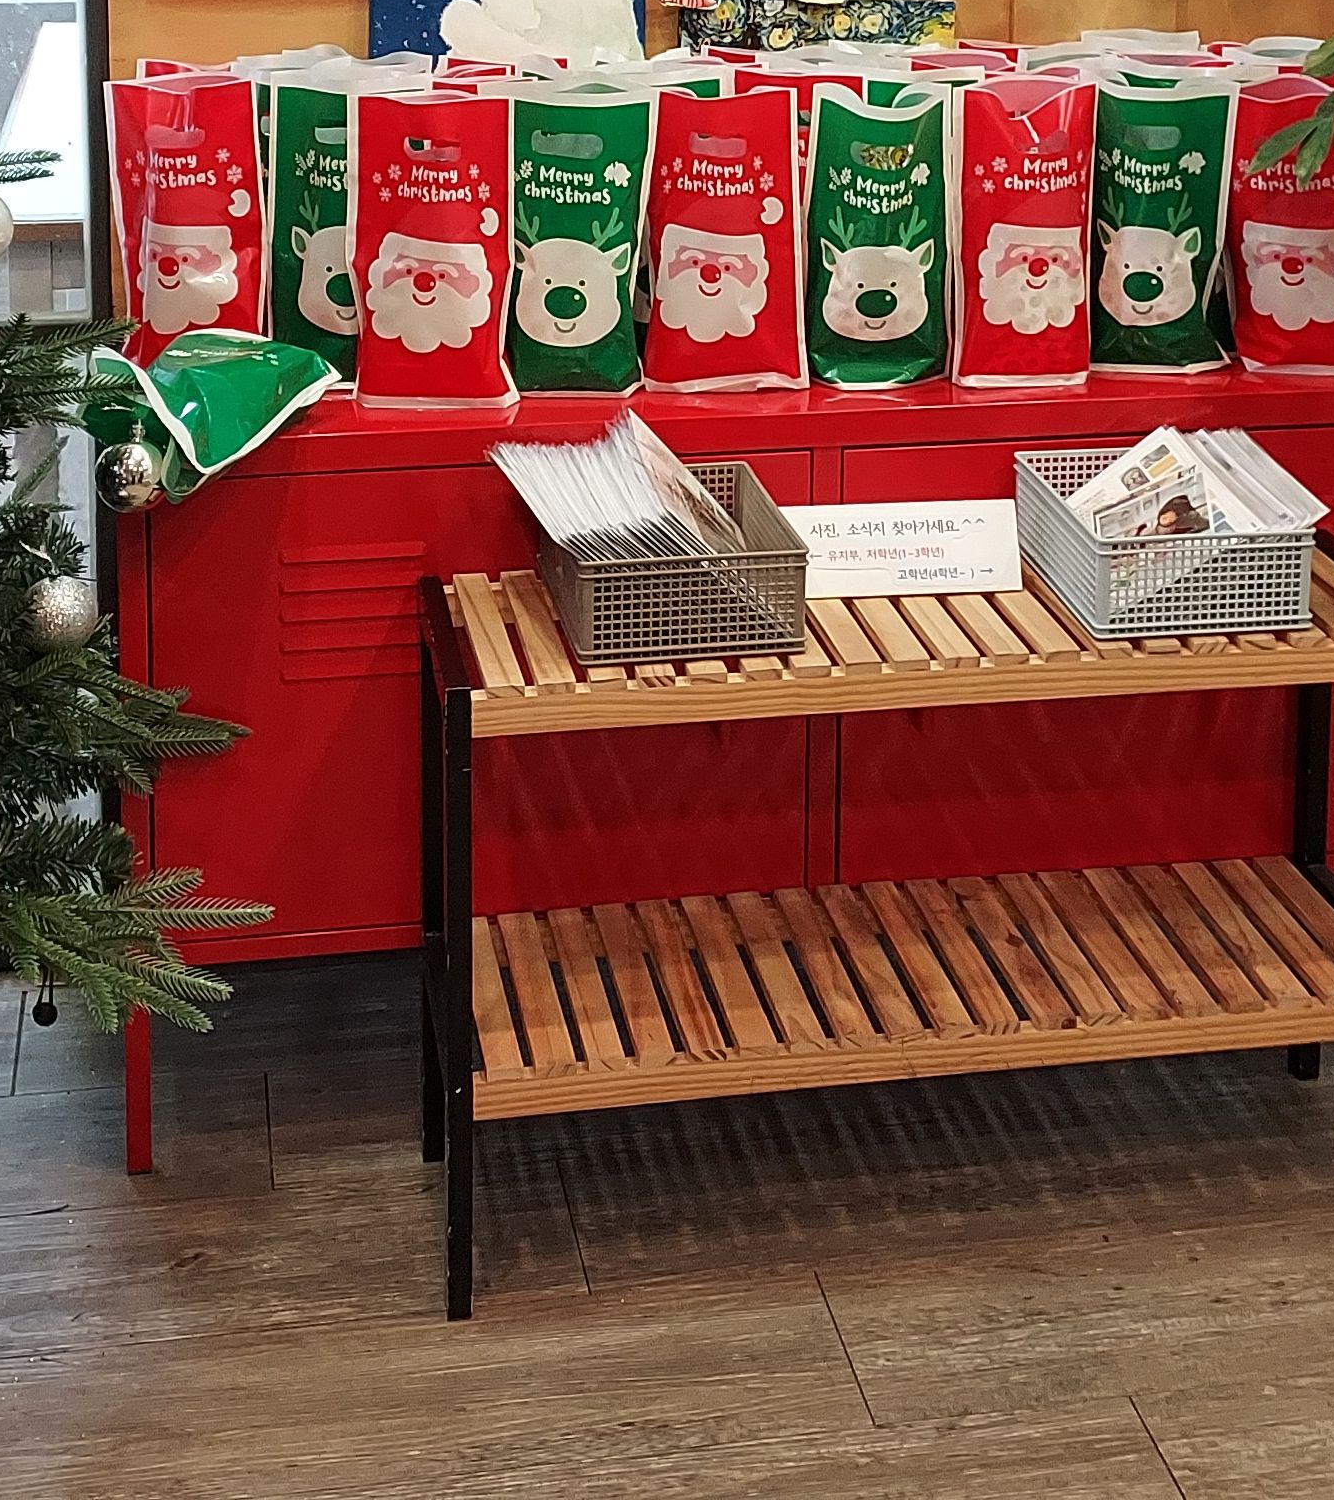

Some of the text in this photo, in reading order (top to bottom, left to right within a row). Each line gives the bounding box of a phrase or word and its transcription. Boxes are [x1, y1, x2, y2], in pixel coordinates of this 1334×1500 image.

[150, 152, 198, 170] Merry
[692, 158, 743, 180] Merry
[1022, 156, 1069, 175] Merry
[1124, 154, 1171, 176] Merry
[410, 164, 460, 185] Merry
[539, 163, 595, 187] Merry
[1003, 171, 1078, 193] christmas
[1113, 171, 1183, 194] christmas
[397, 182, 472, 203] christmas
[524, 182, 611, 205] christmas
[676, 175, 755, 197] christmas
[855, 174, 906, 198] Merry
[842, 190, 914, 215] christmas
[810, 523, 840, 538] 사진,
[846, 521, 886, 536] 소식지
[827, 550, 862, 562] 유치부,
